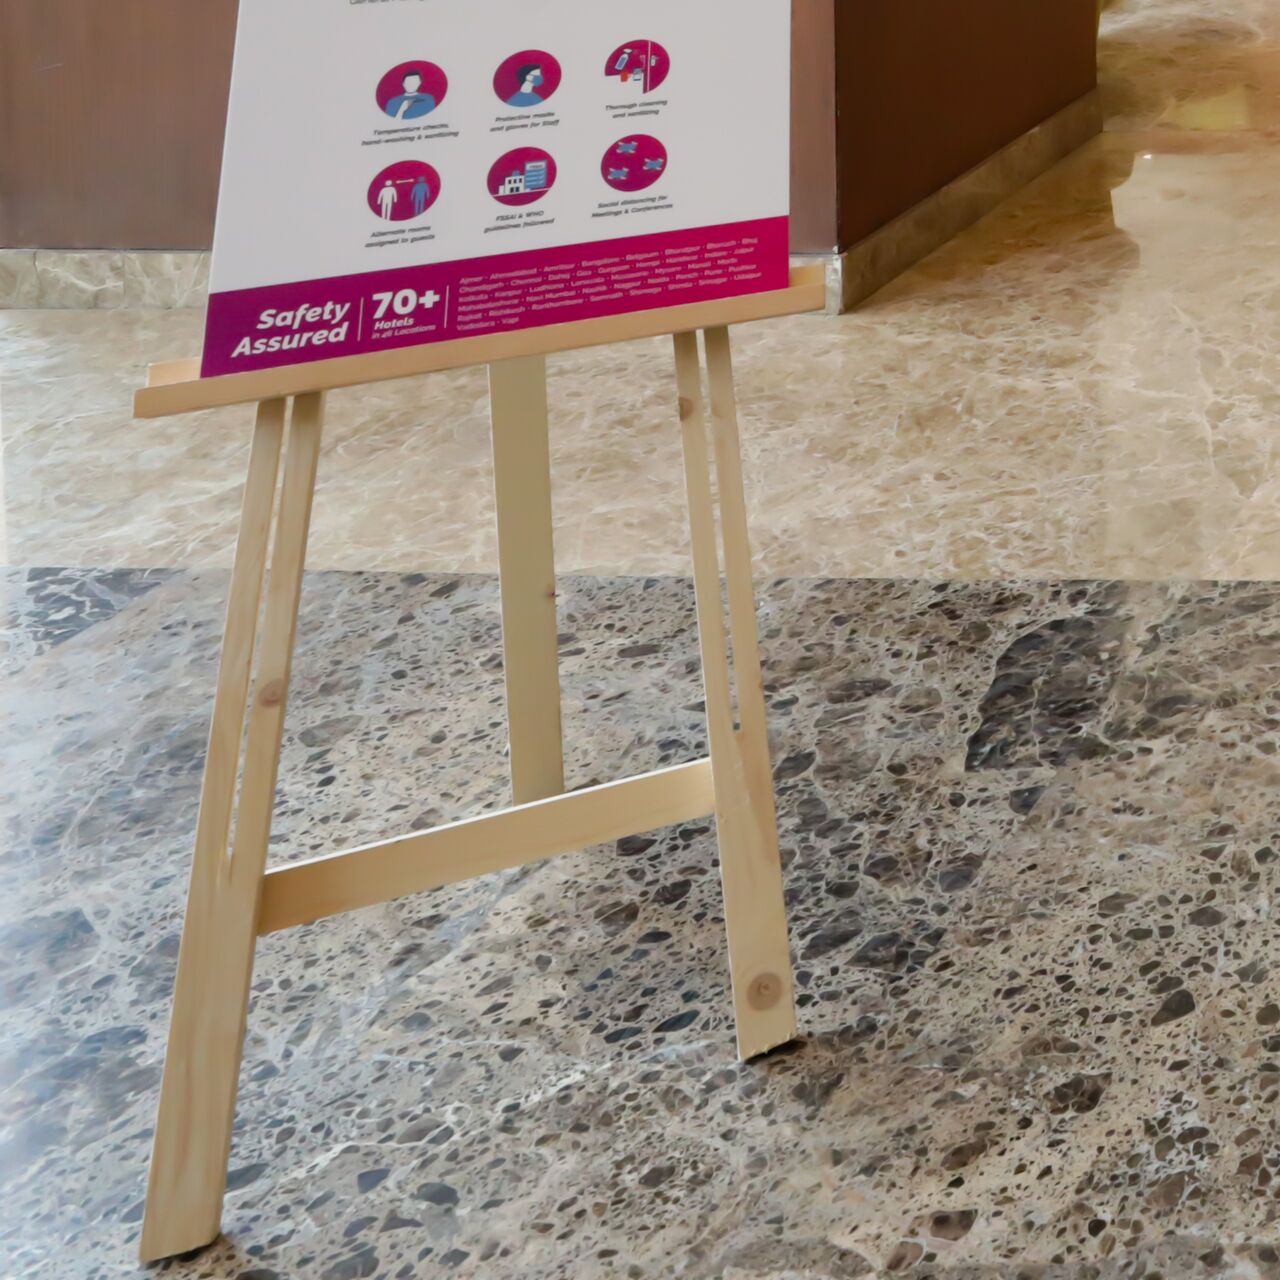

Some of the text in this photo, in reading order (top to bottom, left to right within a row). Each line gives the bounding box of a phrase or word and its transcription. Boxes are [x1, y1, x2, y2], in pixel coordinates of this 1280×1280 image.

[256, 300, 351, 330] Safety
[370, 286, 441, 319] 70+
[230, 321, 348, 358] Assured
